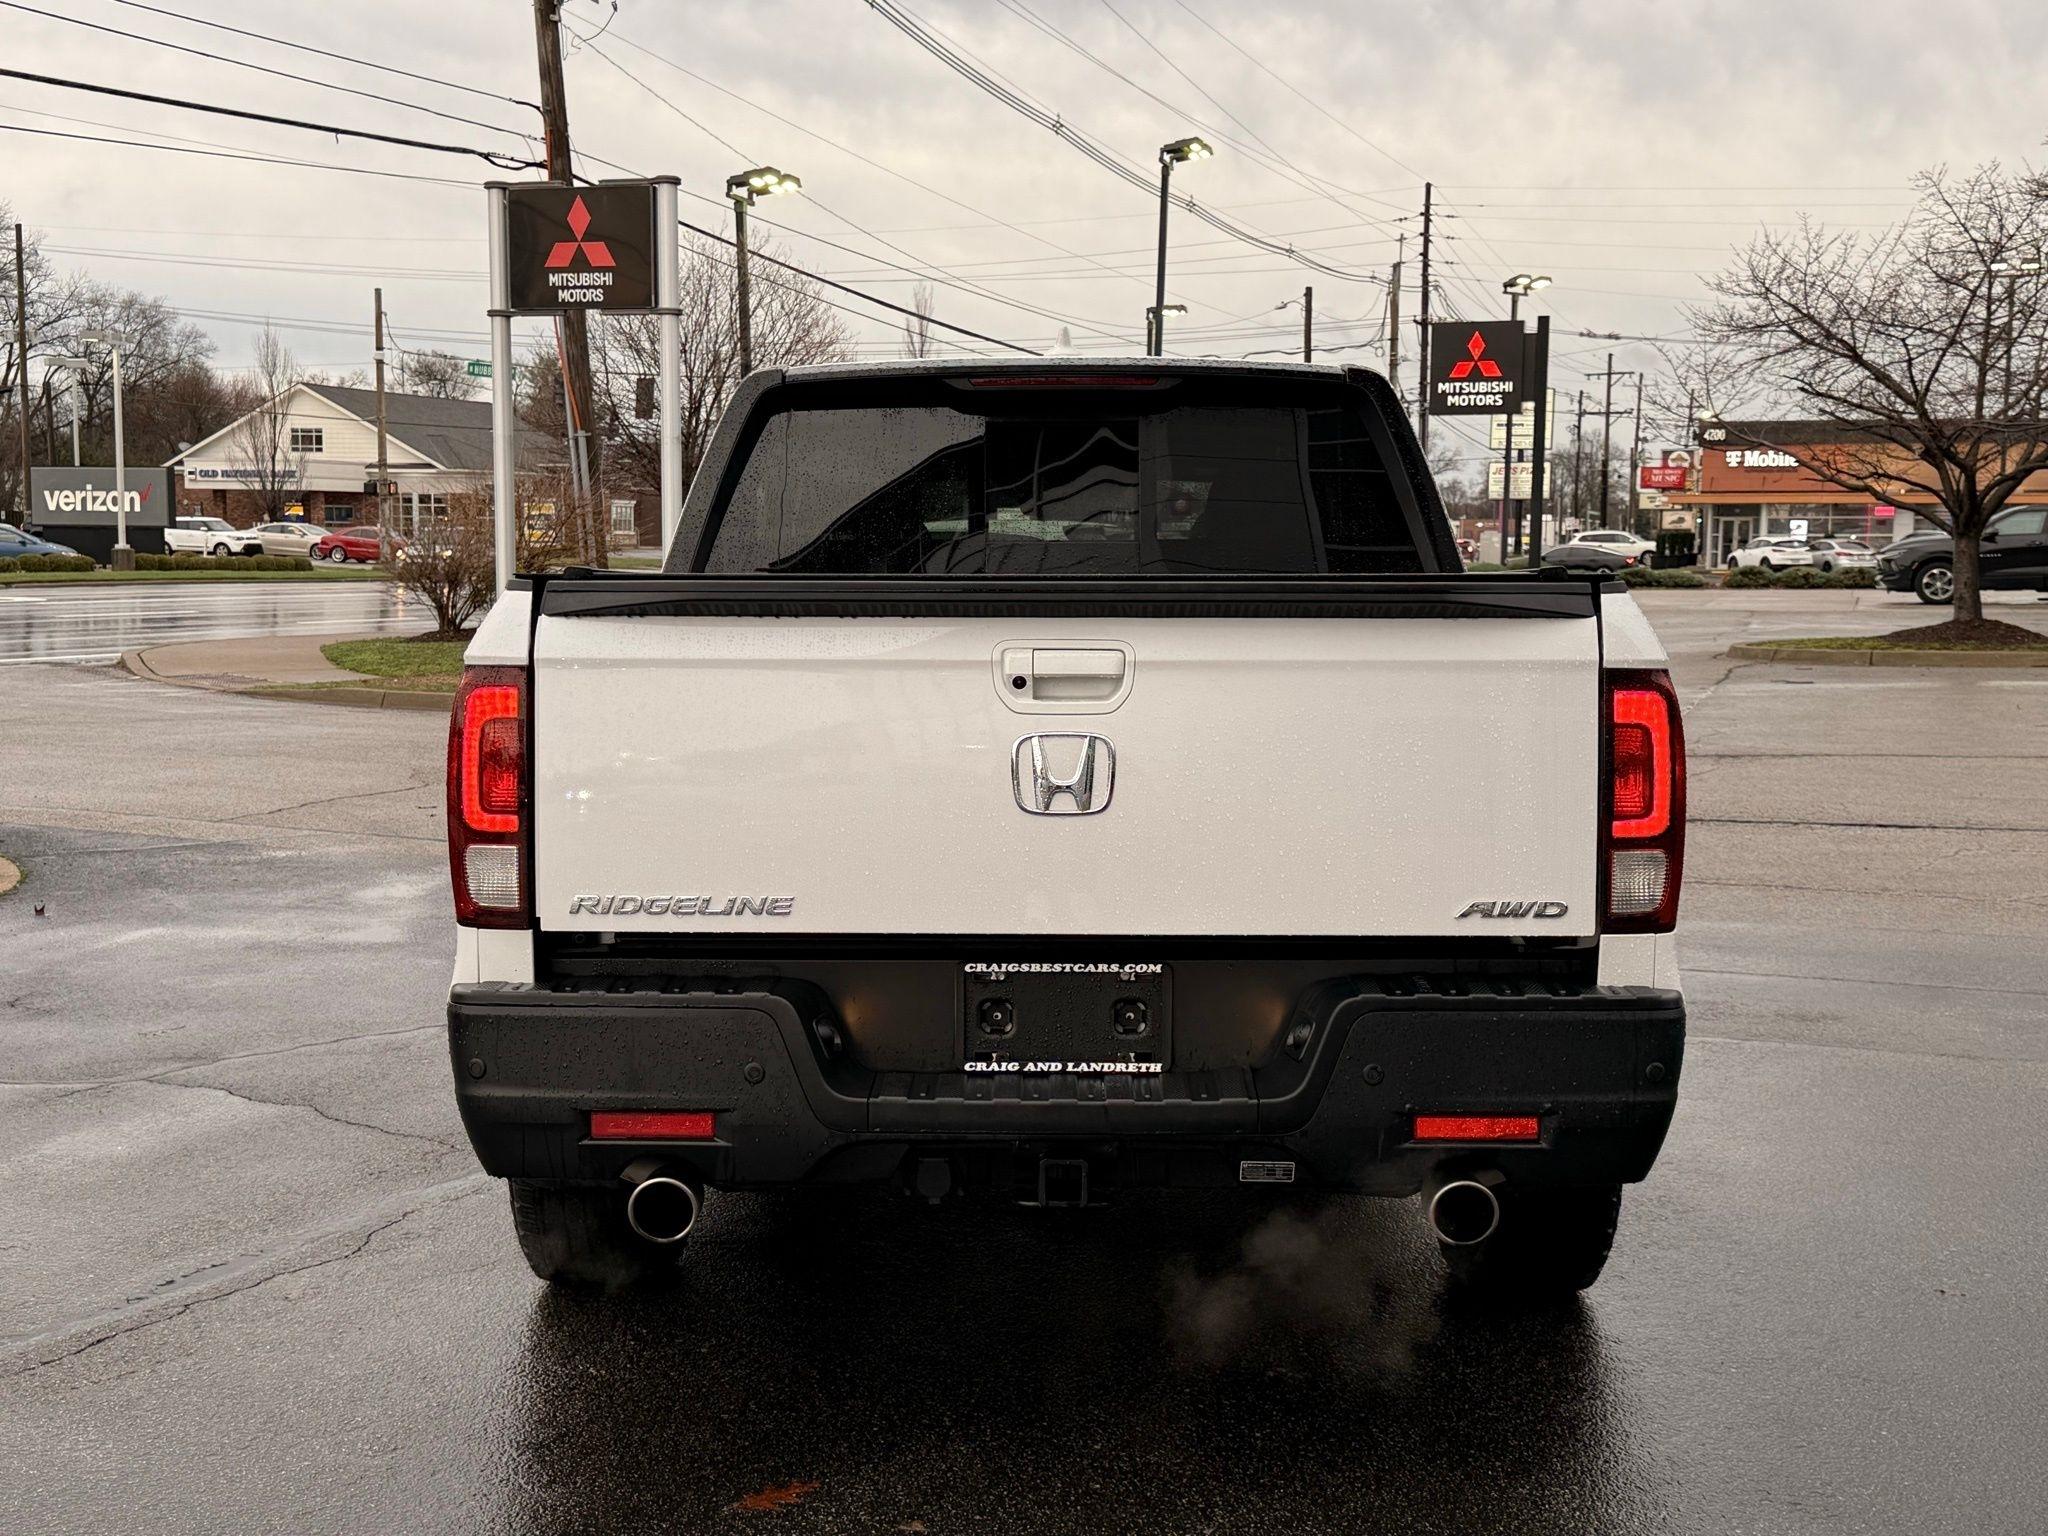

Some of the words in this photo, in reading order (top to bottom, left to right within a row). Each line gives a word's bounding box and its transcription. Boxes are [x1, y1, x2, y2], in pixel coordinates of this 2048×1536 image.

[548, 272, 613, 287] MITSUBISHI
[558, 289, 604, 302] MOTORS
[1437, 381, 1514, 393] MITSUBISHI
[1447, 394, 1504, 407] MOTORS
[43, 483, 141, 513] verizon
[569, 895, 795, 916] RIDGELINE
[1454, 900, 1568, 919] AWD
[964, 963, 1163, 973] CRAIGSBESTCARS.COM
[963, 1061, 1020, 1073] CRAIG
[1023, 1061, 1062, 1073] AND
[1066, 1062, 1163, 1073] LANDRETH
